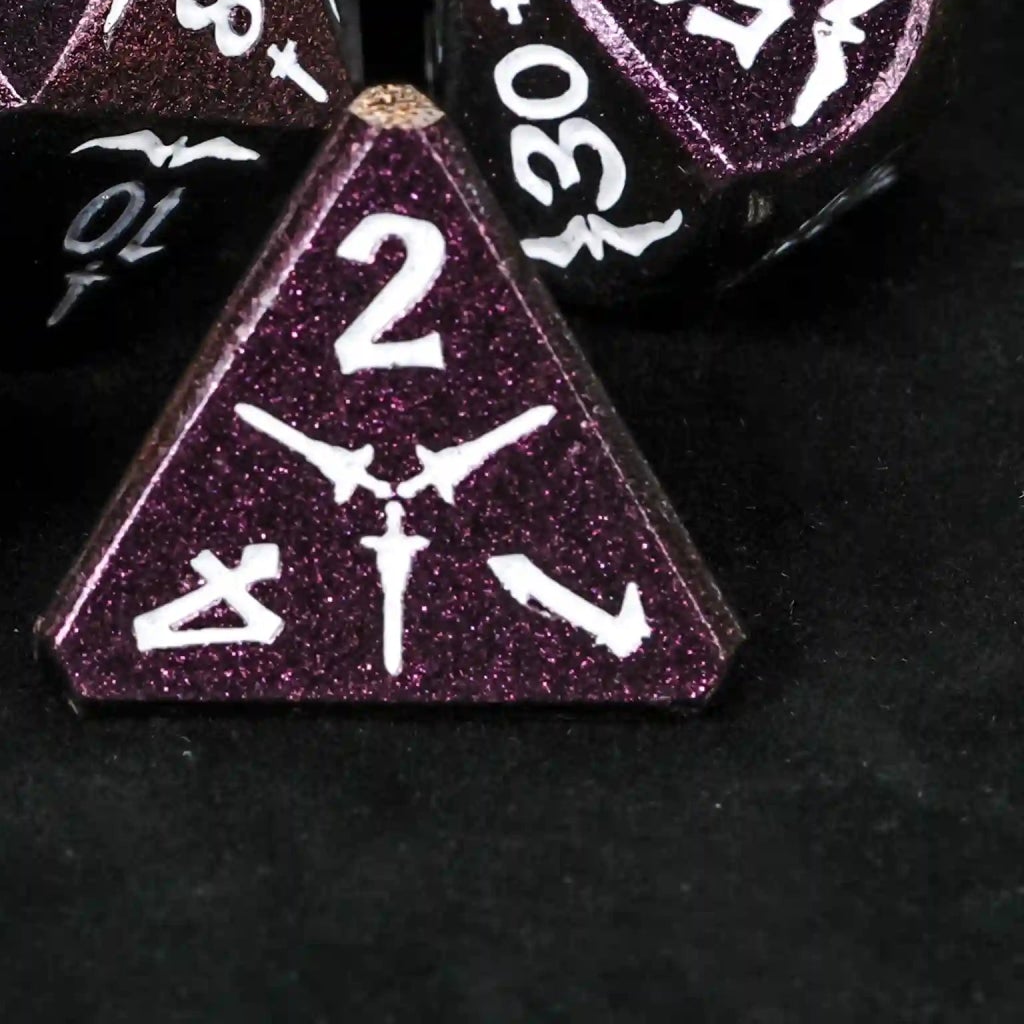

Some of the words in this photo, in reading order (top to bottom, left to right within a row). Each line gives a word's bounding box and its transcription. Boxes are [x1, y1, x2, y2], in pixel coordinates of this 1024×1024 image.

[493, 43, 627, 212] 30
[63, 180, 187, 263] 10
[334, 212, 447, 375] 2
[132, 542, 284, 653] 4
[487, 553, 651, 659] 1
